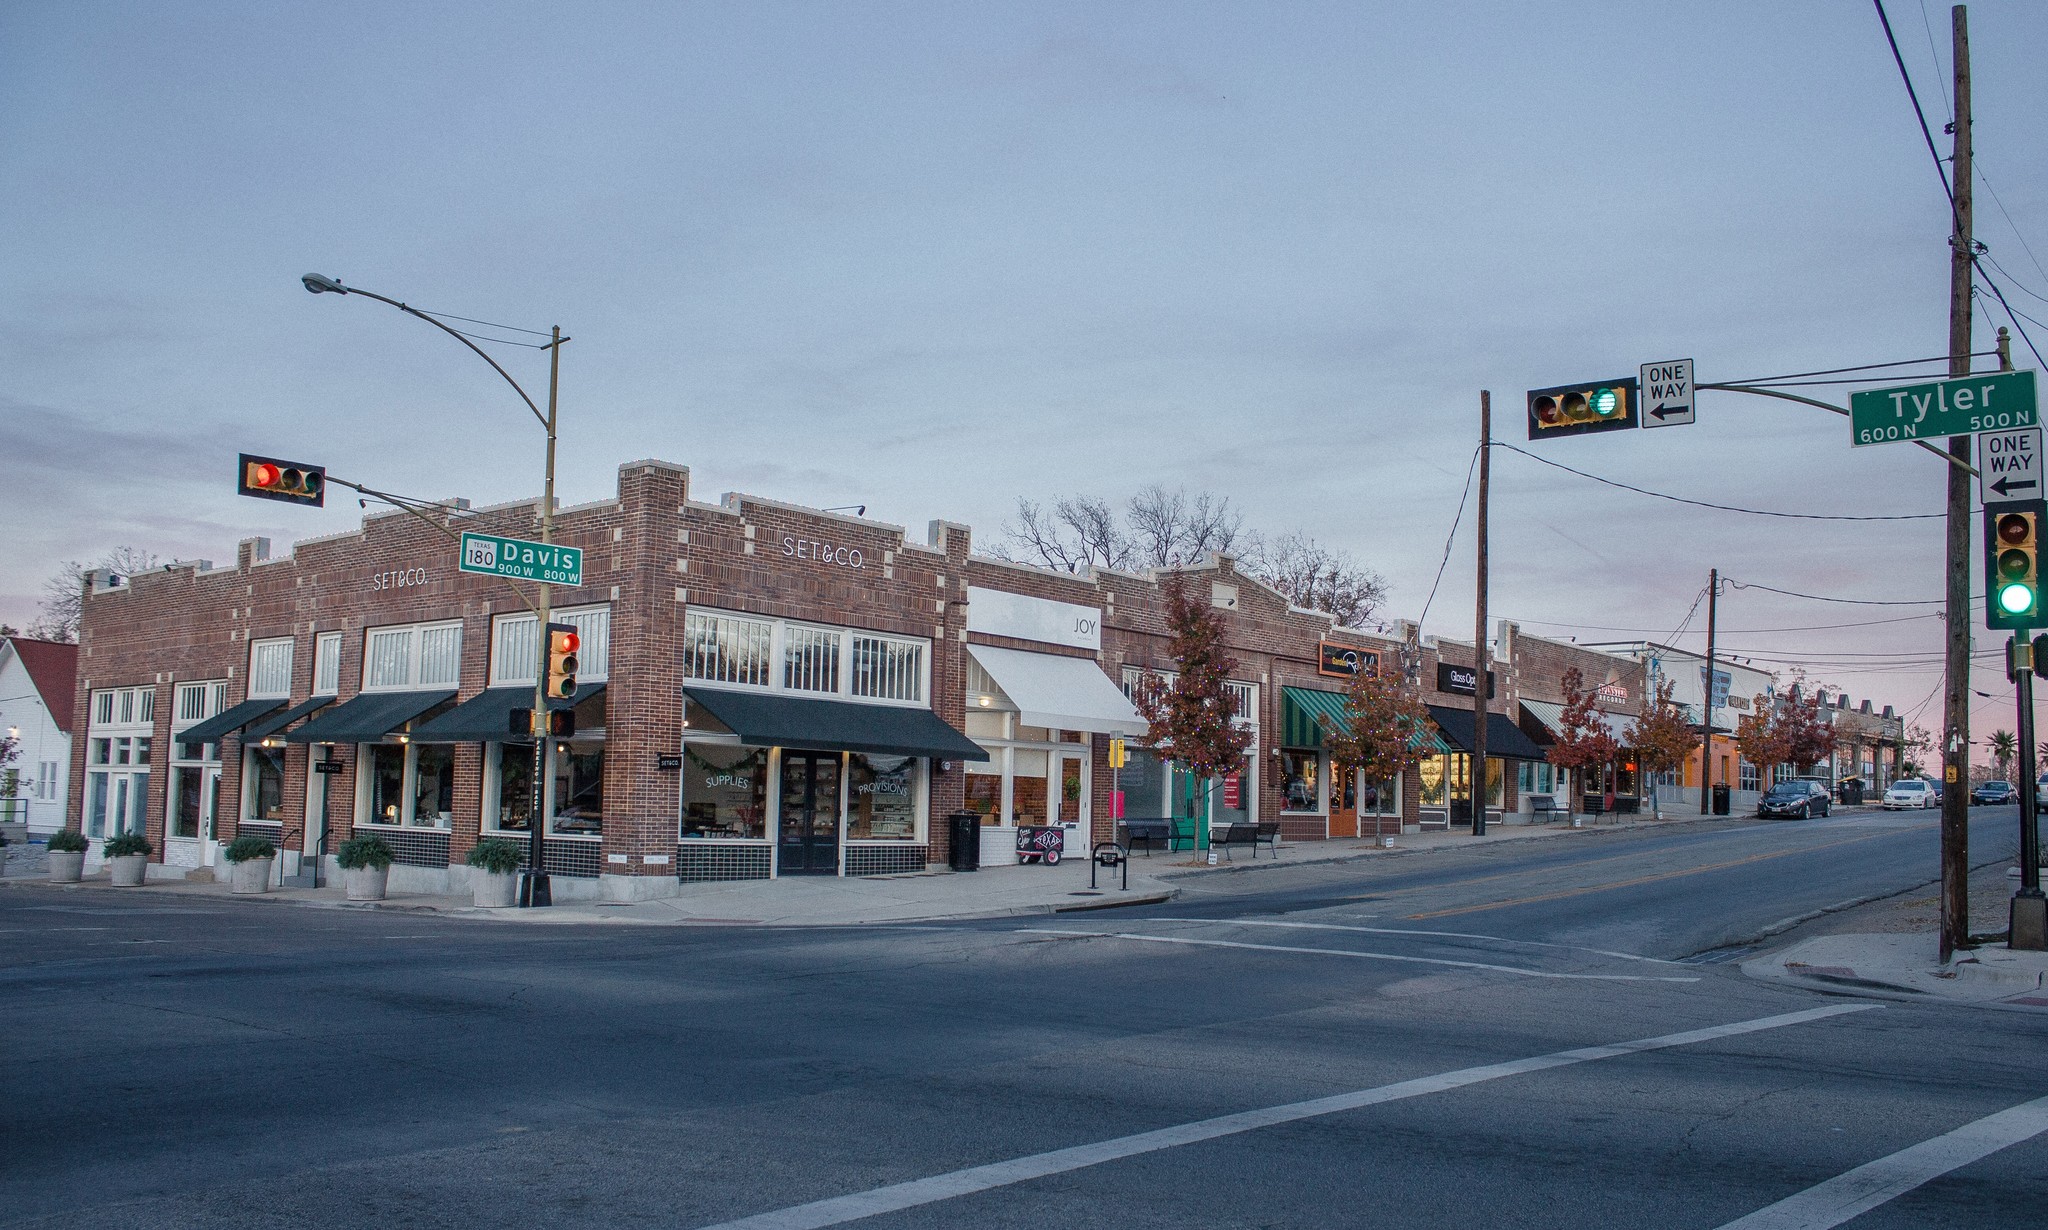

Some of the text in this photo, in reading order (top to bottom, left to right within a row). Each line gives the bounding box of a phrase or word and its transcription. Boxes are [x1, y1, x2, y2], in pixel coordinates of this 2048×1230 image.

[1650, 365, 1685, 382] ONE
[1650, 382, 1687, 400] WAY
[1888, 384, 1995, 423] Tyler
[1970, 411, 2030, 430] 500 N
[1860, 424, 1917, 443] 600 N
[1989, 435, 2031, 454] ONE
[1990, 453, 2034, 473] WAY
[473, 541, 491, 550] TEXAS
[782, 536, 866, 569] SET&CO.
[468, 549, 494, 566] 180
[503, 542, 574, 570] Davis
[373, 567, 428, 591] SET&CO.
[498, 563, 534, 577] 900 W
[544, 569, 579, 583] 800 W
[1073, 617, 1097, 636] JOY
[1599, 694, 1626, 705] RECORDS
[705, 775, 749, 790] SUPPLIES
[858, 781, 908, 797] PROVISIONS
